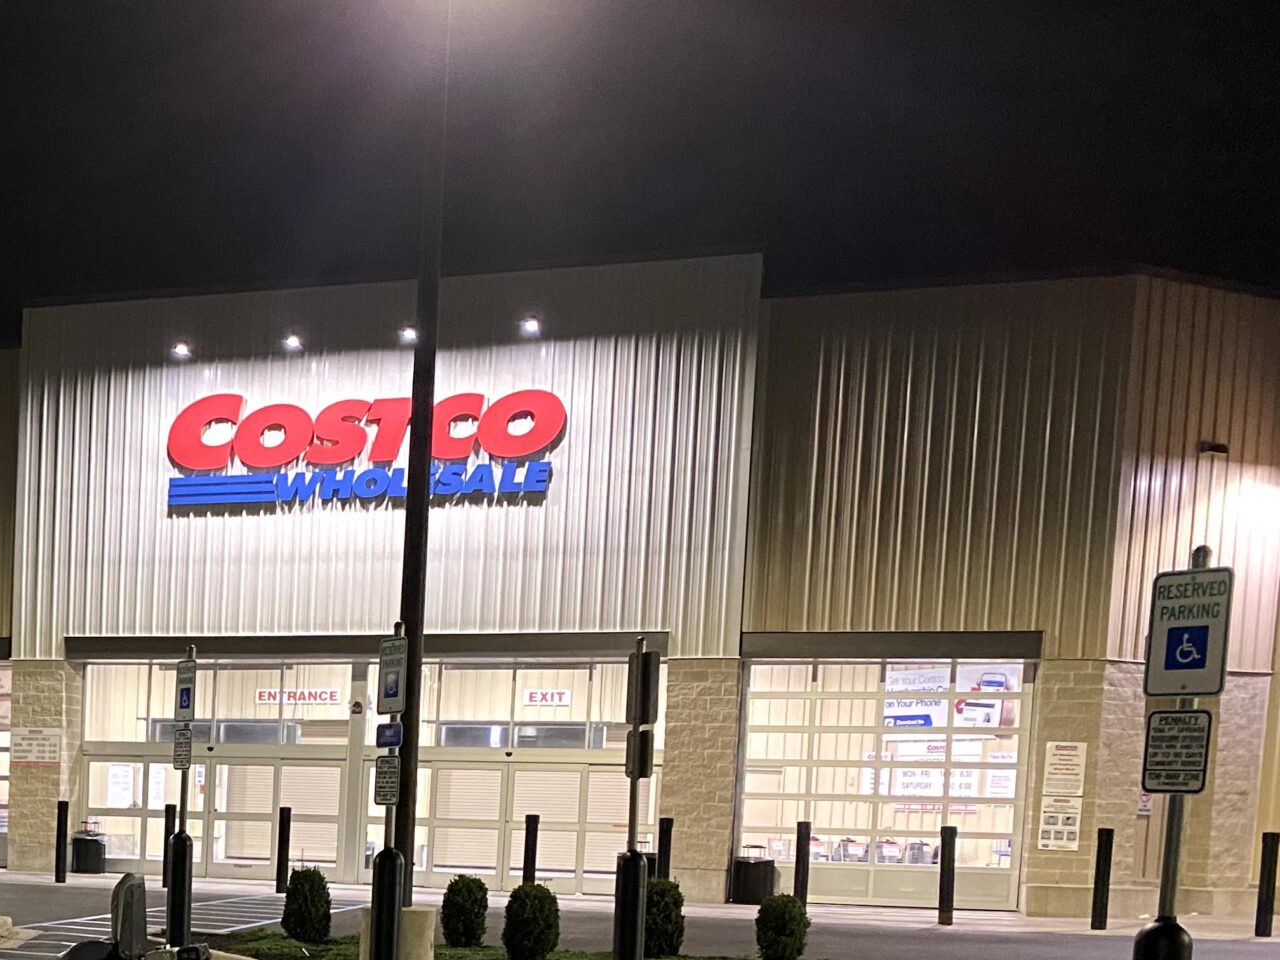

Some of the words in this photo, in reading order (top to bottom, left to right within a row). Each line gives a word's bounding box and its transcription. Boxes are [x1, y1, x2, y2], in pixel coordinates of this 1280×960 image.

[168, 389, 566, 470] COSTCO
[275, 461, 552, 501] WHOLSALE
[1158, 580, 1227, 600] RESERVED
[1160, 602, 1220, 621] PARKING
[258, 691, 338, 701] ENTRANCE
[529, 692, 566, 702] EXIT
[896, 699, 914, 708] Your
[916, 698, 941, 707] Phone
[1159, 715, 1200, 726] PENALTY
